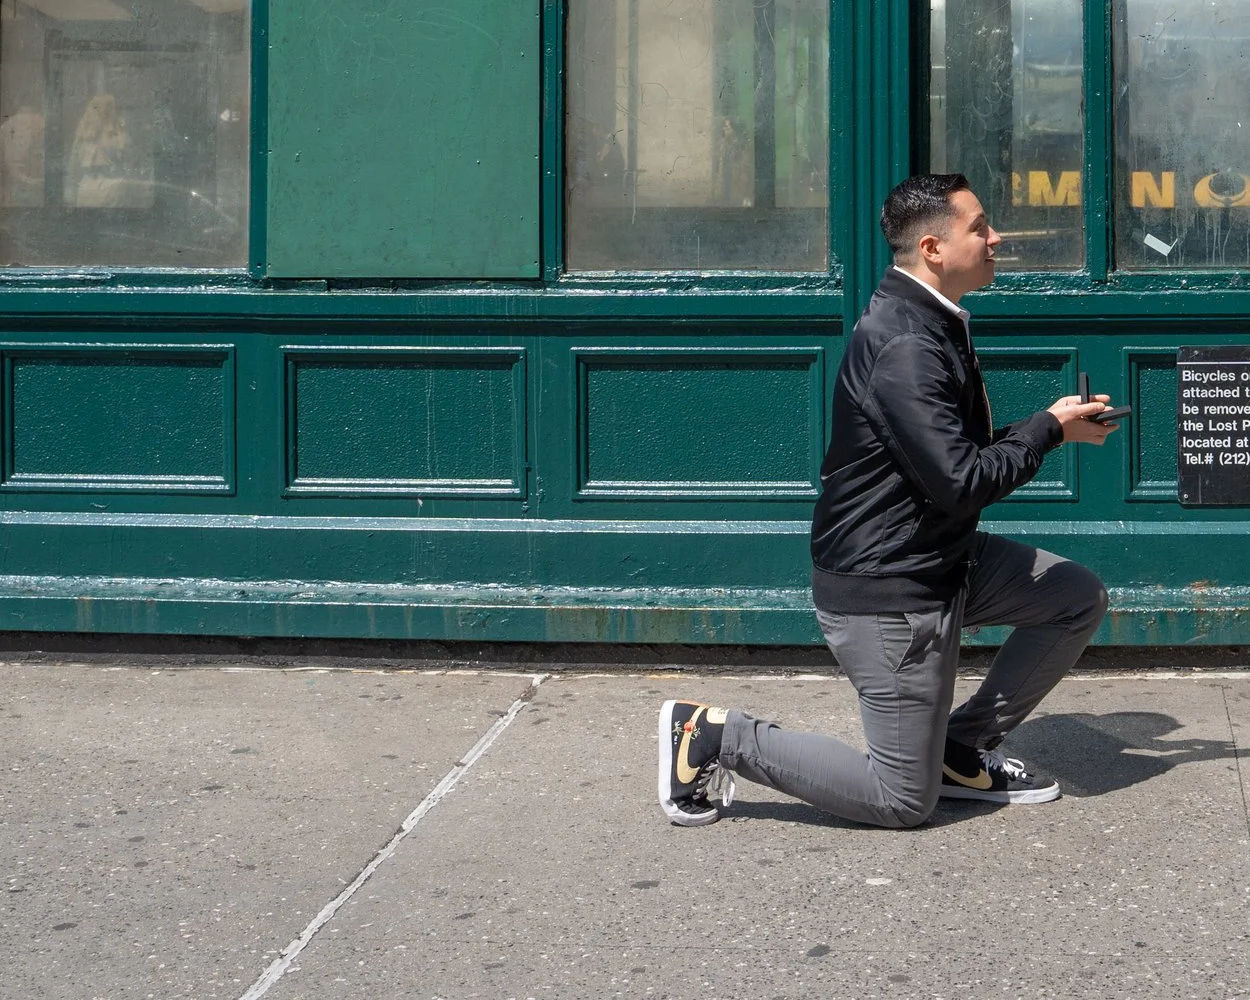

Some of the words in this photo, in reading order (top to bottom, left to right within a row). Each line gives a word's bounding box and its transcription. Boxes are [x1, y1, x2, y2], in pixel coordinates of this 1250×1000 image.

[1183, 370, 1235, 383] Bicycles
[1183, 387, 1239, 397] attached
[1183, 403, 1199, 414] be
[1183, 420, 1203, 431] the
[1209, 420, 1237, 431] Lost
[1183, 437, 1230, 448] located
[1236, 437, 1248, 447] at
[1184, 453, 1213, 464] Tel.#
[1219, 452, 1250, 465] (212)
